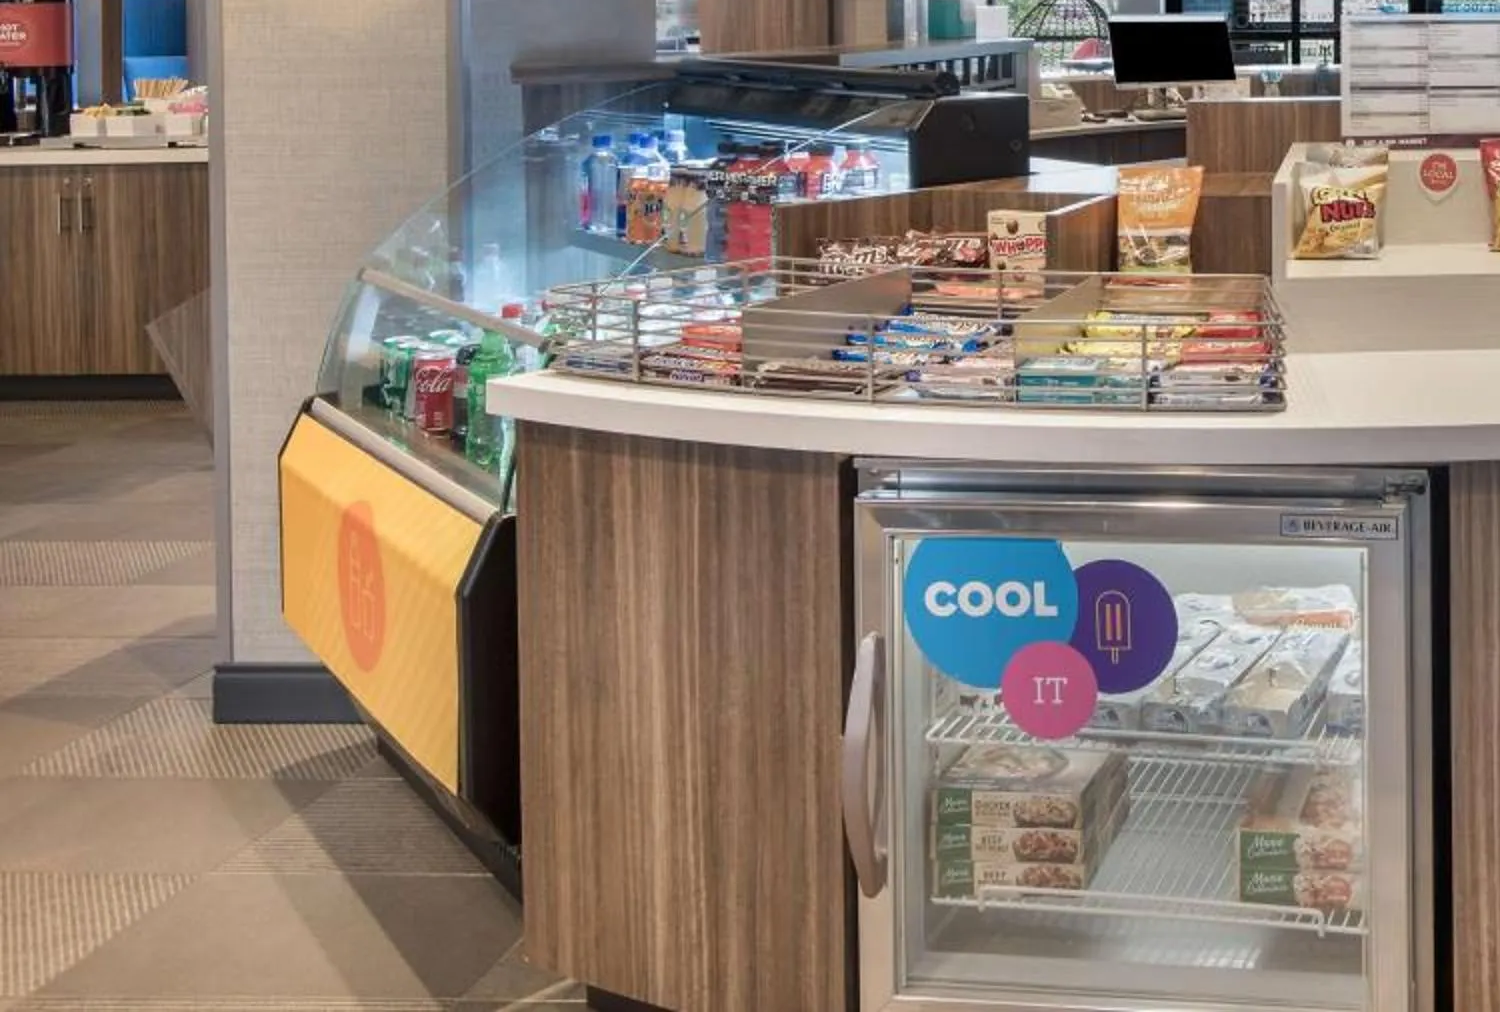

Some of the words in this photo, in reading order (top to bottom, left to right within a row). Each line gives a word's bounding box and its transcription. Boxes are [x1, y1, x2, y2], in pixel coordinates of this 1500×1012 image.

[0, 31, 27, 41] ATER
[991, 235, 1048, 254] WHOPP
[1302, 518, 1392, 534] BEVERAGE-AIR
[924, 580, 1058, 618] COOL
[1032, 676, 1068, 706] IT
